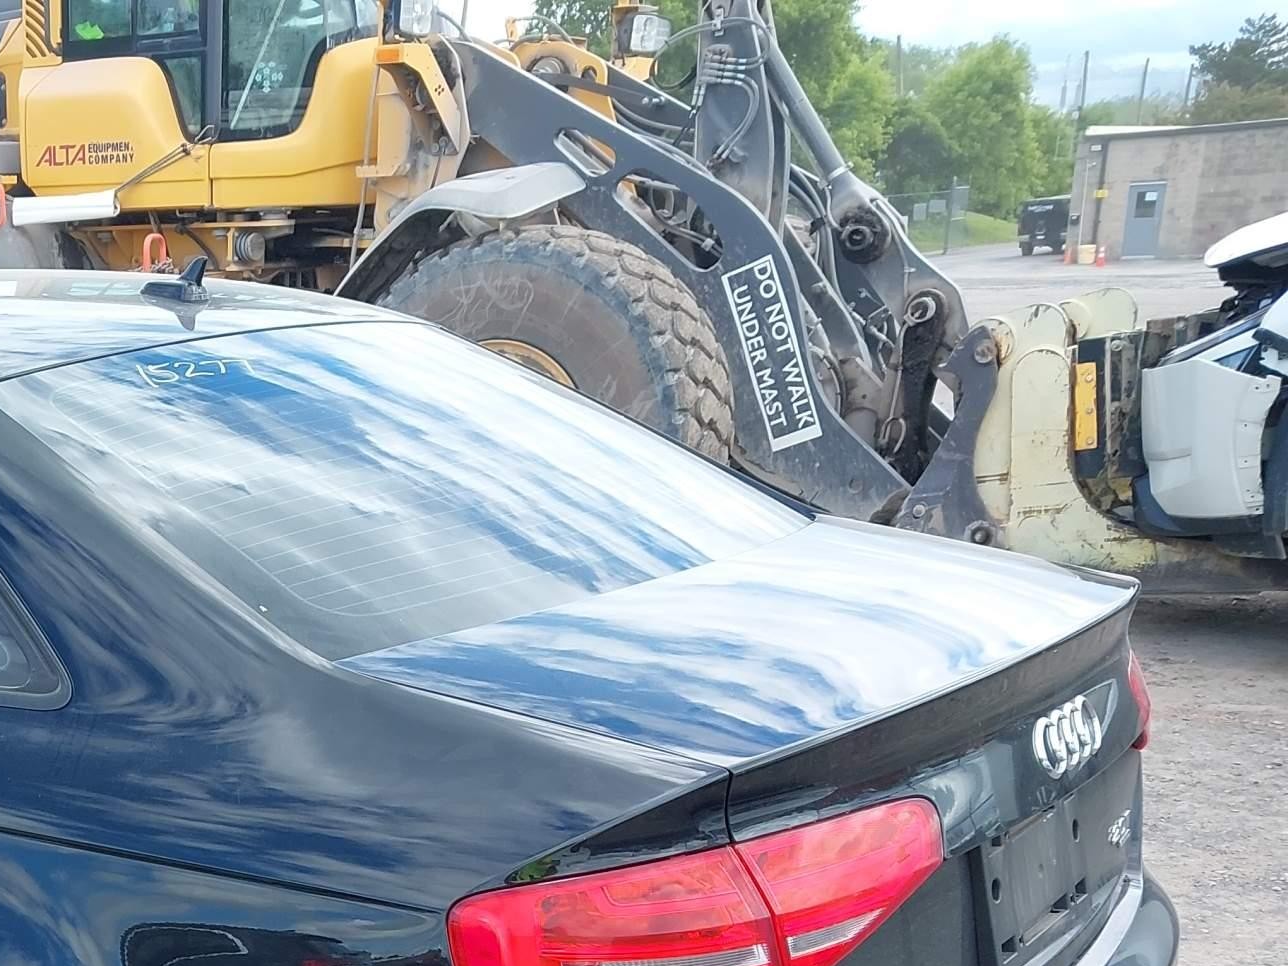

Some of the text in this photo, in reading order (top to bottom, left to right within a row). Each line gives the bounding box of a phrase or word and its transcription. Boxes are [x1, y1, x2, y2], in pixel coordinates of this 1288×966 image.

[36, 143, 86, 167] ALTA
[87, 141, 134, 154] EQUIPMEN
[87, 153, 134, 165] COMPANY
[733, 284, 788, 428] UNDER MAST
[753, 261, 816, 429] DO NOT WALK
[135, 358, 256, 388] 15277
